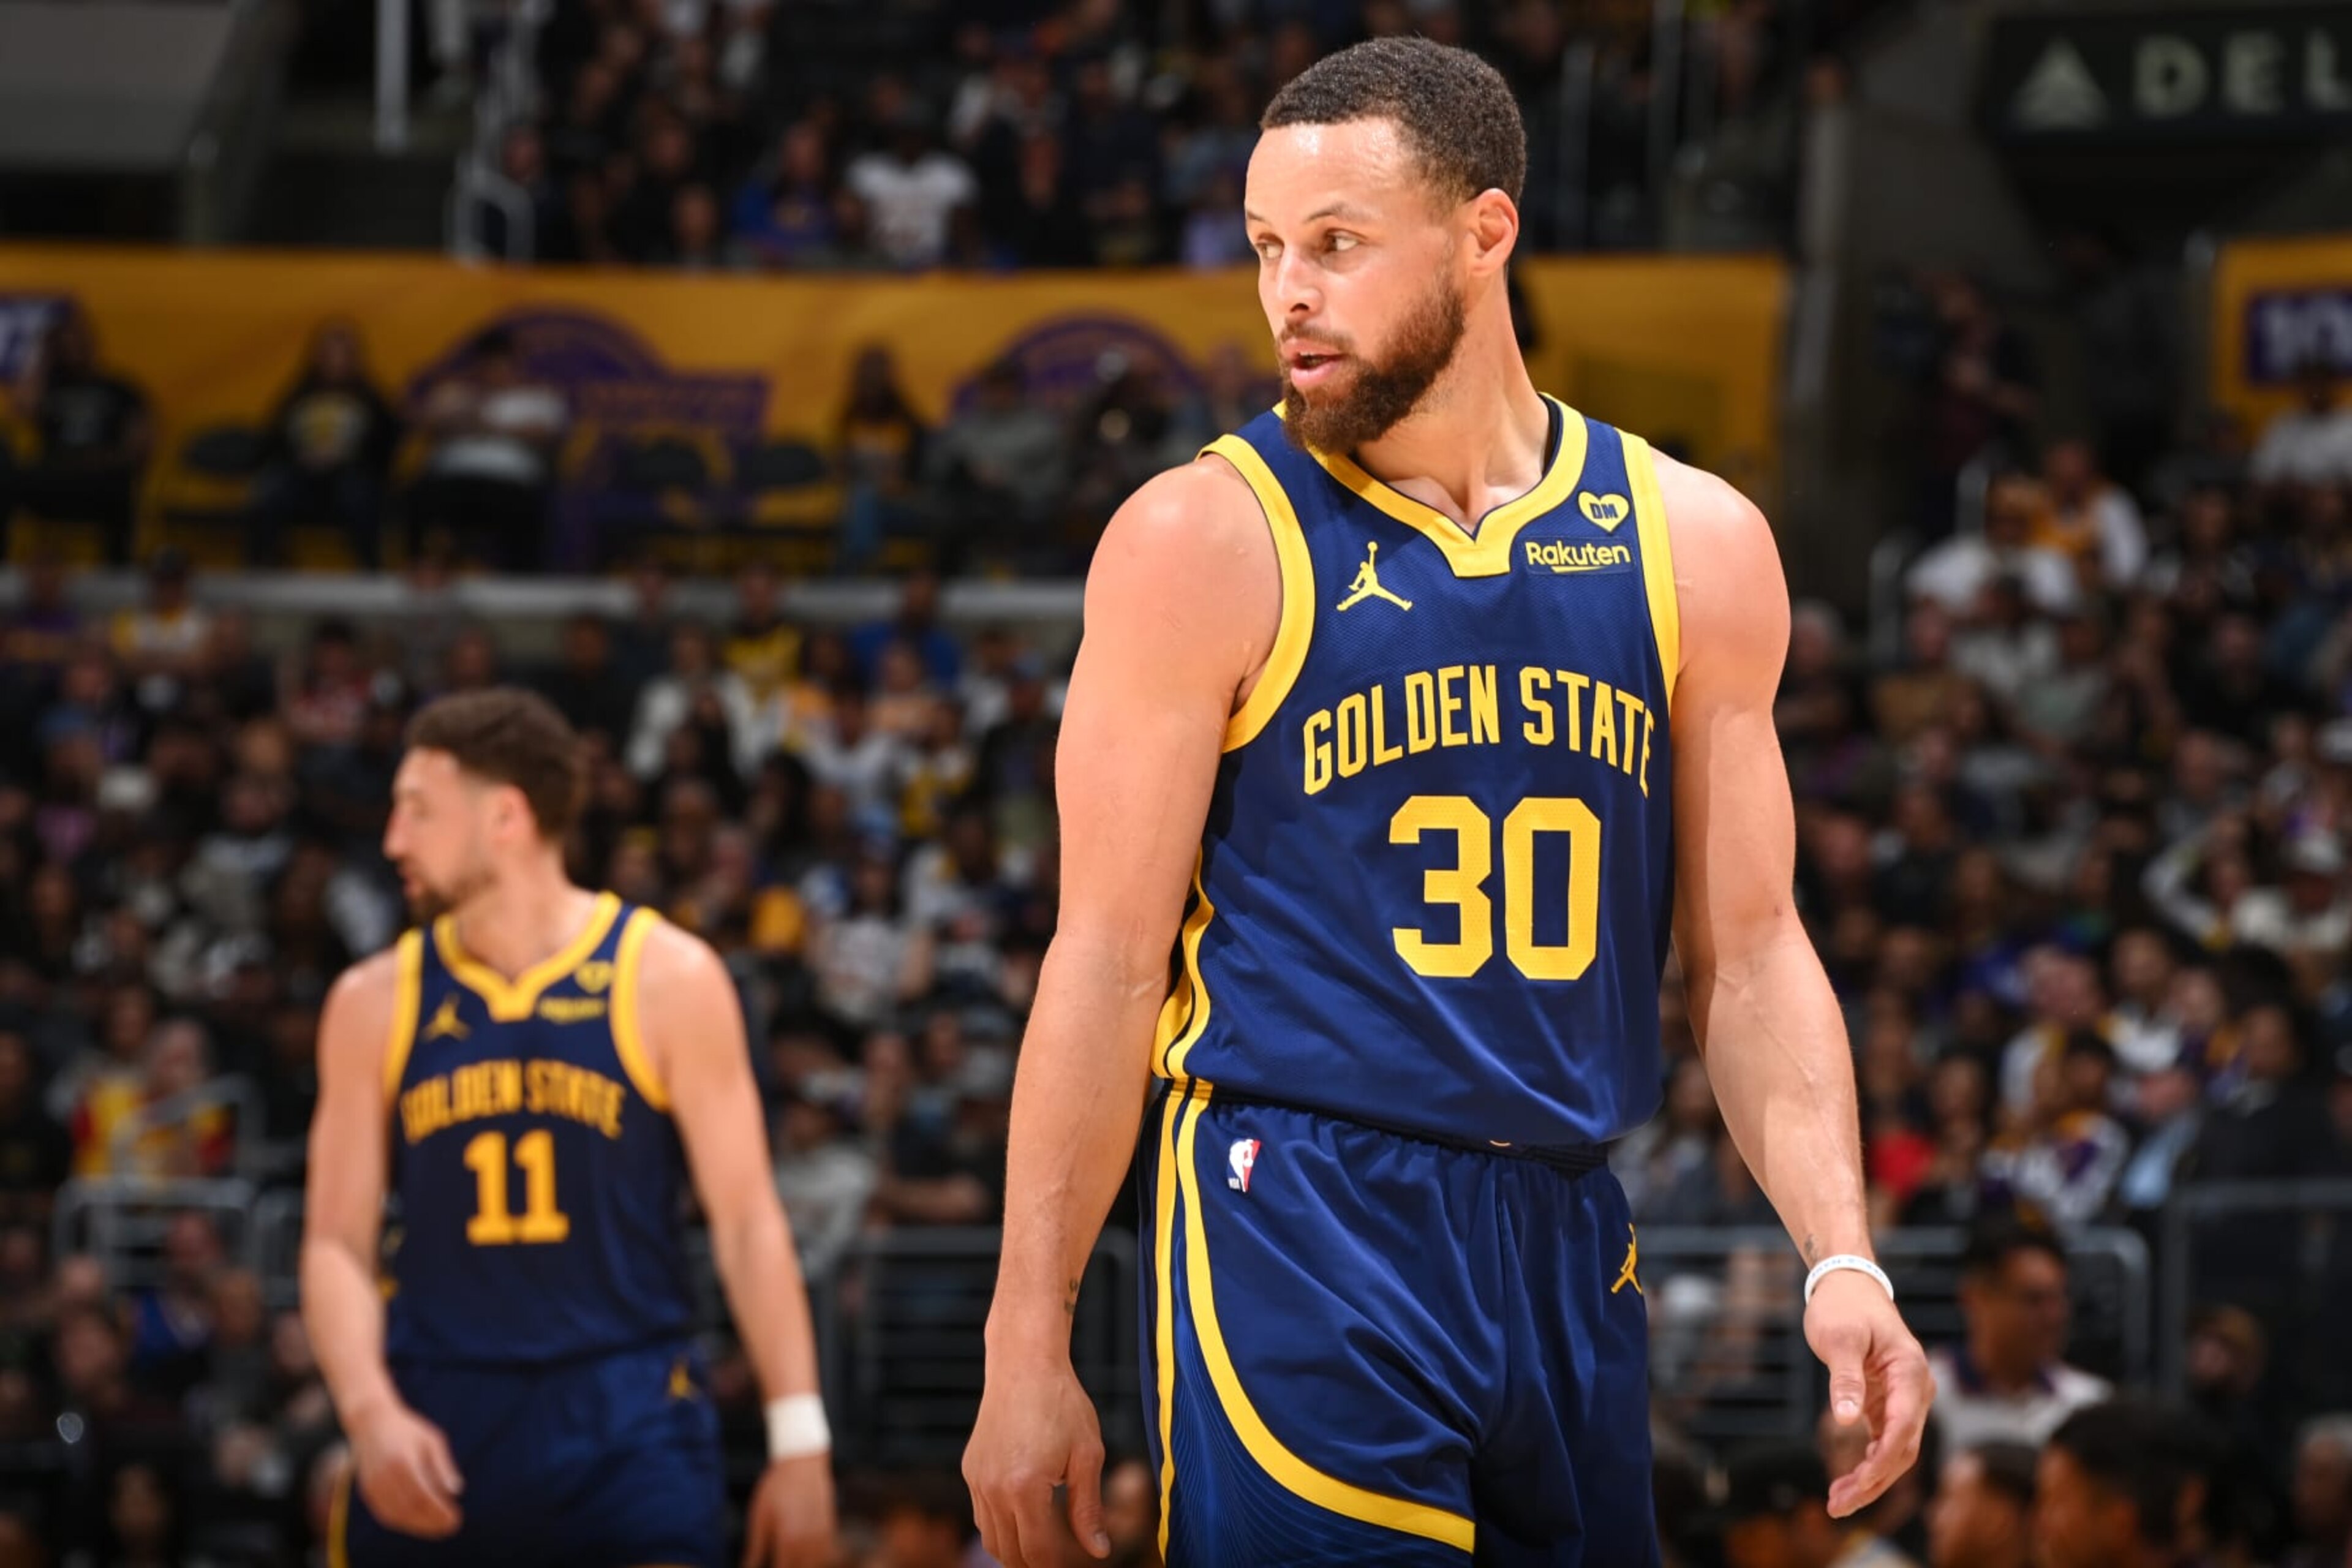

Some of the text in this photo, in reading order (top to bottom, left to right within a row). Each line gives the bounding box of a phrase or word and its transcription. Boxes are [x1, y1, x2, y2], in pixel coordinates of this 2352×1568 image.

[1525, 540, 1631, 566] Rakuten
[1589, 502, 1618, 519] DM
[1303, 665, 1654, 799] GOLDEN STATE
[1389, 796, 1601, 980] 30
[401, 1058, 625, 1144] GOLDEN STATE
[463, 1128, 569, 1246] 11
